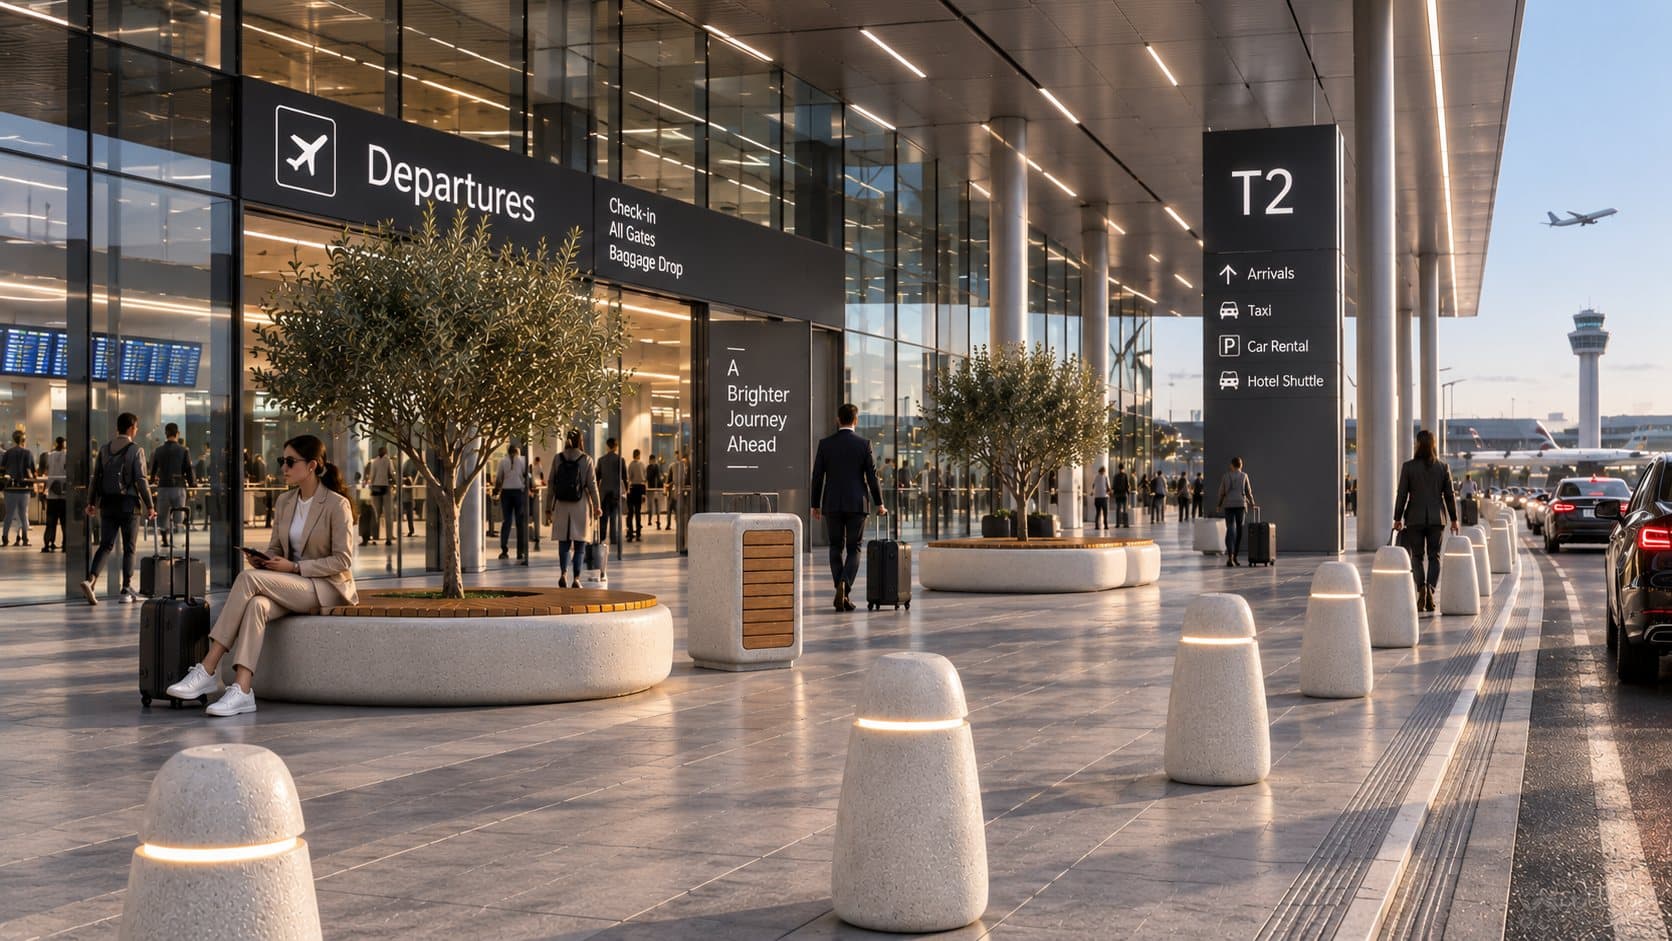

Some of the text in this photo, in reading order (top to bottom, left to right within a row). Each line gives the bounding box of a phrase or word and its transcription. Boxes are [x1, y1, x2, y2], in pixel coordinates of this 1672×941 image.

[368, 143, 536, 222] Departures
[1231, 168, 1294, 216] T2
[609, 197, 656, 225] Check-in
[609, 221, 656, 248] All Gates
[609, 244, 684, 280] Baggage Drop
[1247, 266, 1295, 281] Arrivals
[1247, 304, 1272, 317] Taxi
[1224, 338, 1309, 355] P Car Rental
[727, 359, 740, 377] A
[1247, 374, 1325, 388] Hotel Shuttle
[727, 384, 790, 407] Brighter
[727, 410, 788, 432] Journey
[727, 435, 777, 453] Ahead
